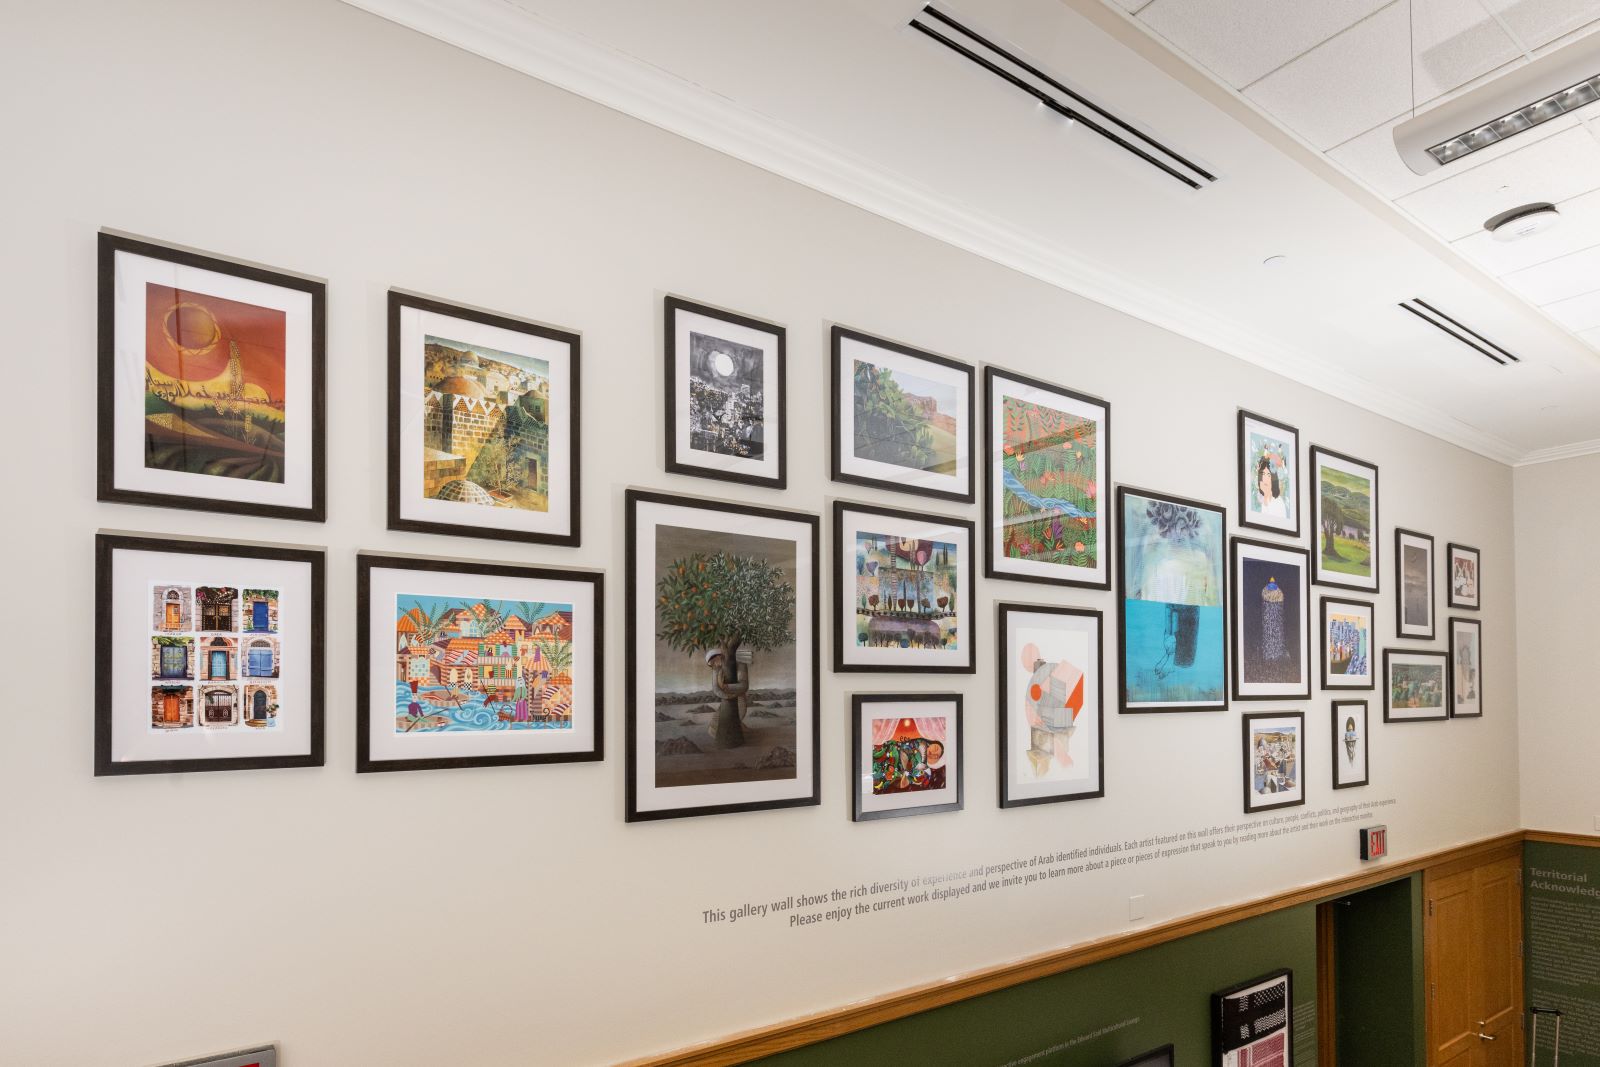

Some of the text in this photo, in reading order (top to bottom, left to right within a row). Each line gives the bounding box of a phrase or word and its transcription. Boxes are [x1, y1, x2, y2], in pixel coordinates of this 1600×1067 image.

[702, 909, 726, 923] This
[730, 904, 768, 922] gallery
[770, 897, 793, 912] wall
[796, 894, 828, 907] shows
[830, 889, 846, 901] the
[850, 885, 868, 898] rich
[870, 879, 908, 894] diversity
[910, 876, 920, 887] of
[922, 871, 966, 886] experience
[969, 866, 984, 877] and
[984, 860, 1028, 877] perspective
[1028, 857, 1036, 866] of
[1037, 854, 1054, 865] Arab
[1056, 848, 1088, 862] identified
[1088, 844, 1122, 856] individuals.
[1124, 840, 1138, 850] Each
[1139, 838, 1154, 847] artist
[1154, 833, 1178, 844] featured
[1186, 831, 1197, 839] this
[1197, 829, 1208, 837] wall
[1208, 827, 1224, 835] offers
[1236, 821, 1260, 832] perspective
[1370, 830, 1385, 857] EXIT
[790, 912, 822, 926] Please
[824, 906, 852, 920] enjoy
[854, 902, 870, 914] the
[872, 896, 905, 911] current
[906, 890, 929, 904] work
[930, 883, 969, 900] displayed
[971, 880, 986, 892] and
[988, 880, 999, 889] we
[1000, 875, 1022, 887] invite
[1024, 873, 1036, 885] you
[1038, 871, 1046, 880] to
[1048, 868, 1064, 878] learn
[1066, 865, 1082, 875] more
[1084, 860, 1104, 871] about
[1110, 857, 1126, 869] piece
[1134, 852, 1152, 864] pieces
[1154, 849, 1160, 858] of
[1161, 845, 1188, 858] expression
[1190, 843, 1200, 851] that
[1200, 839, 1216, 851] speak
[1222, 838, 1232, 847] you
[1232, 835, 1240, 845] by
[1240, 833, 1256, 842] reading
[1257, 831, 1269, 839] more
[1529, 867, 1588, 883] Territorial
